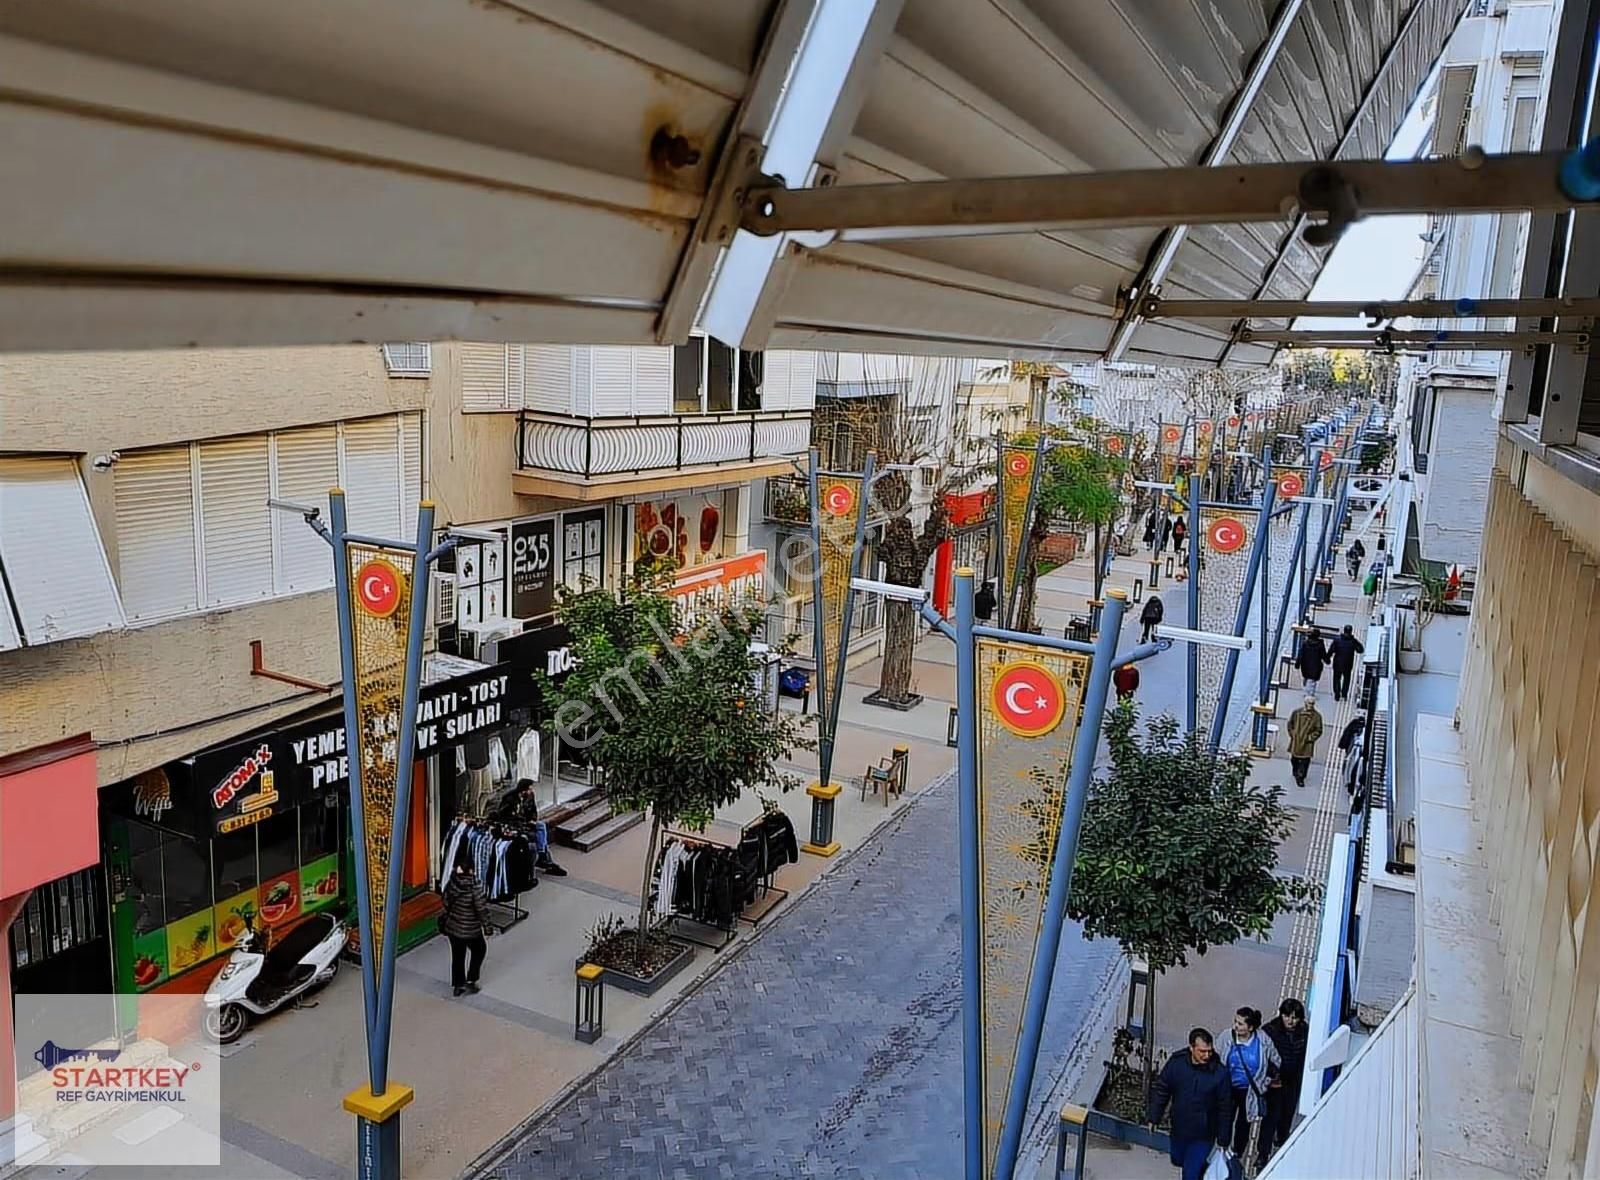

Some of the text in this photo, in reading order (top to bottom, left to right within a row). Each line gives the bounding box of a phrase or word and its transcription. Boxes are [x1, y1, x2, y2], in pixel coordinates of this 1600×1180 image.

[293, 728, 346, 764] YEME
[470, 676, 509, 706] TOST
[446, 703, 501, 739] SULARI
